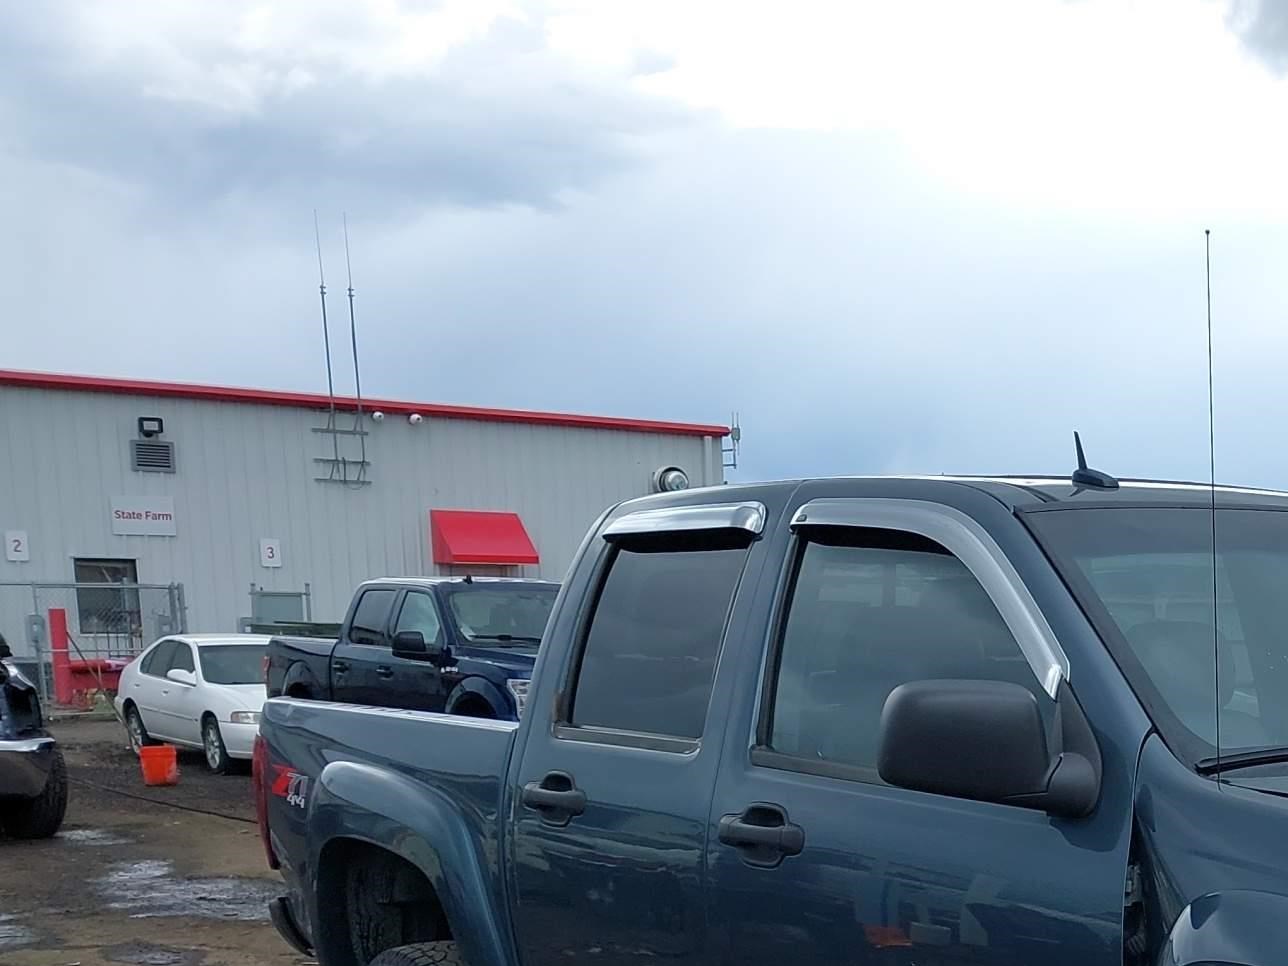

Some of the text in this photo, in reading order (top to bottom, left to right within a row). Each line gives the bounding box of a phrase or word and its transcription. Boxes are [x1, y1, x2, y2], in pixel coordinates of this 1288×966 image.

[113, 509, 172, 521] State Farm
[12, 538, 23, 553] 2
[266, 546, 275, 560] 3
